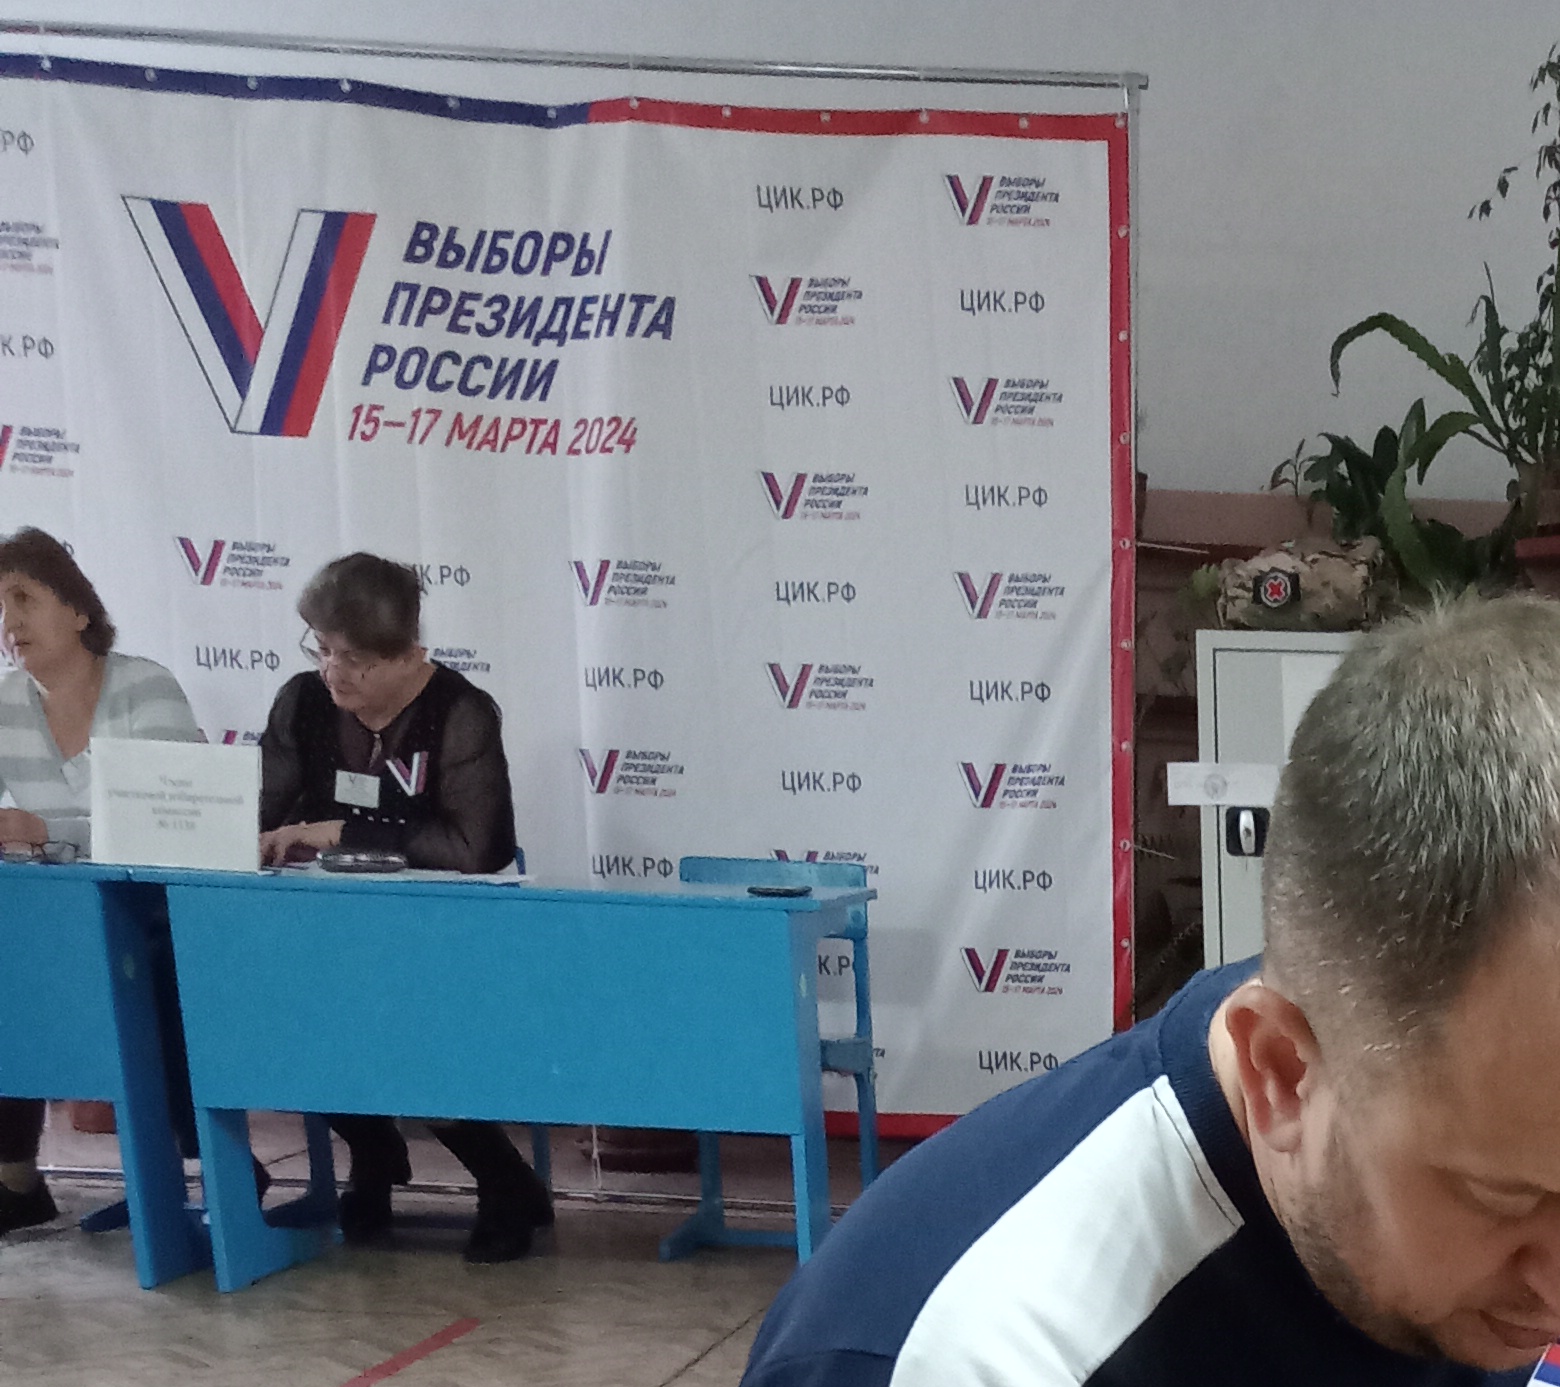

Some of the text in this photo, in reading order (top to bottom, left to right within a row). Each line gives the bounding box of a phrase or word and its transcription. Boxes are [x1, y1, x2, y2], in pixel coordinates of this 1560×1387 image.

[756, 185, 844, 213] ЦИК.РФ
[402, 220, 613, 277] ВЫБОРЫ
[381, 281, 676, 347] ПРЕЗИДЕНТА
[961, 289, 1045, 316] ЦИК.РФ
[361, 343, 559, 402] РОССИИ
[769, 385, 850, 410] ЦИК.РФ
[445, 411, 561, 455] МАРТА
[566, 416, 638, 456] 2024
[966, 485, 1048, 510] ЦИК.РФ
[420, 565, 471, 587] К.РФ
[776, 580, 857, 605] ЦИК.РФ
[195, 646, 281, 671] ЦИК.РФ
[585, 667, 665, 691] ЦИК.РФ
[969, 680, 1052, 705] ЦИК.РФ
[782, 770, 862, 795] ЦИК.РФ
[592, 855, 674, 879] ЦИК.РФ
[974, 869, 1053, 893] ЦИК.РФ
[978, 1050, 1059, 1075] ЦИК.РФ
